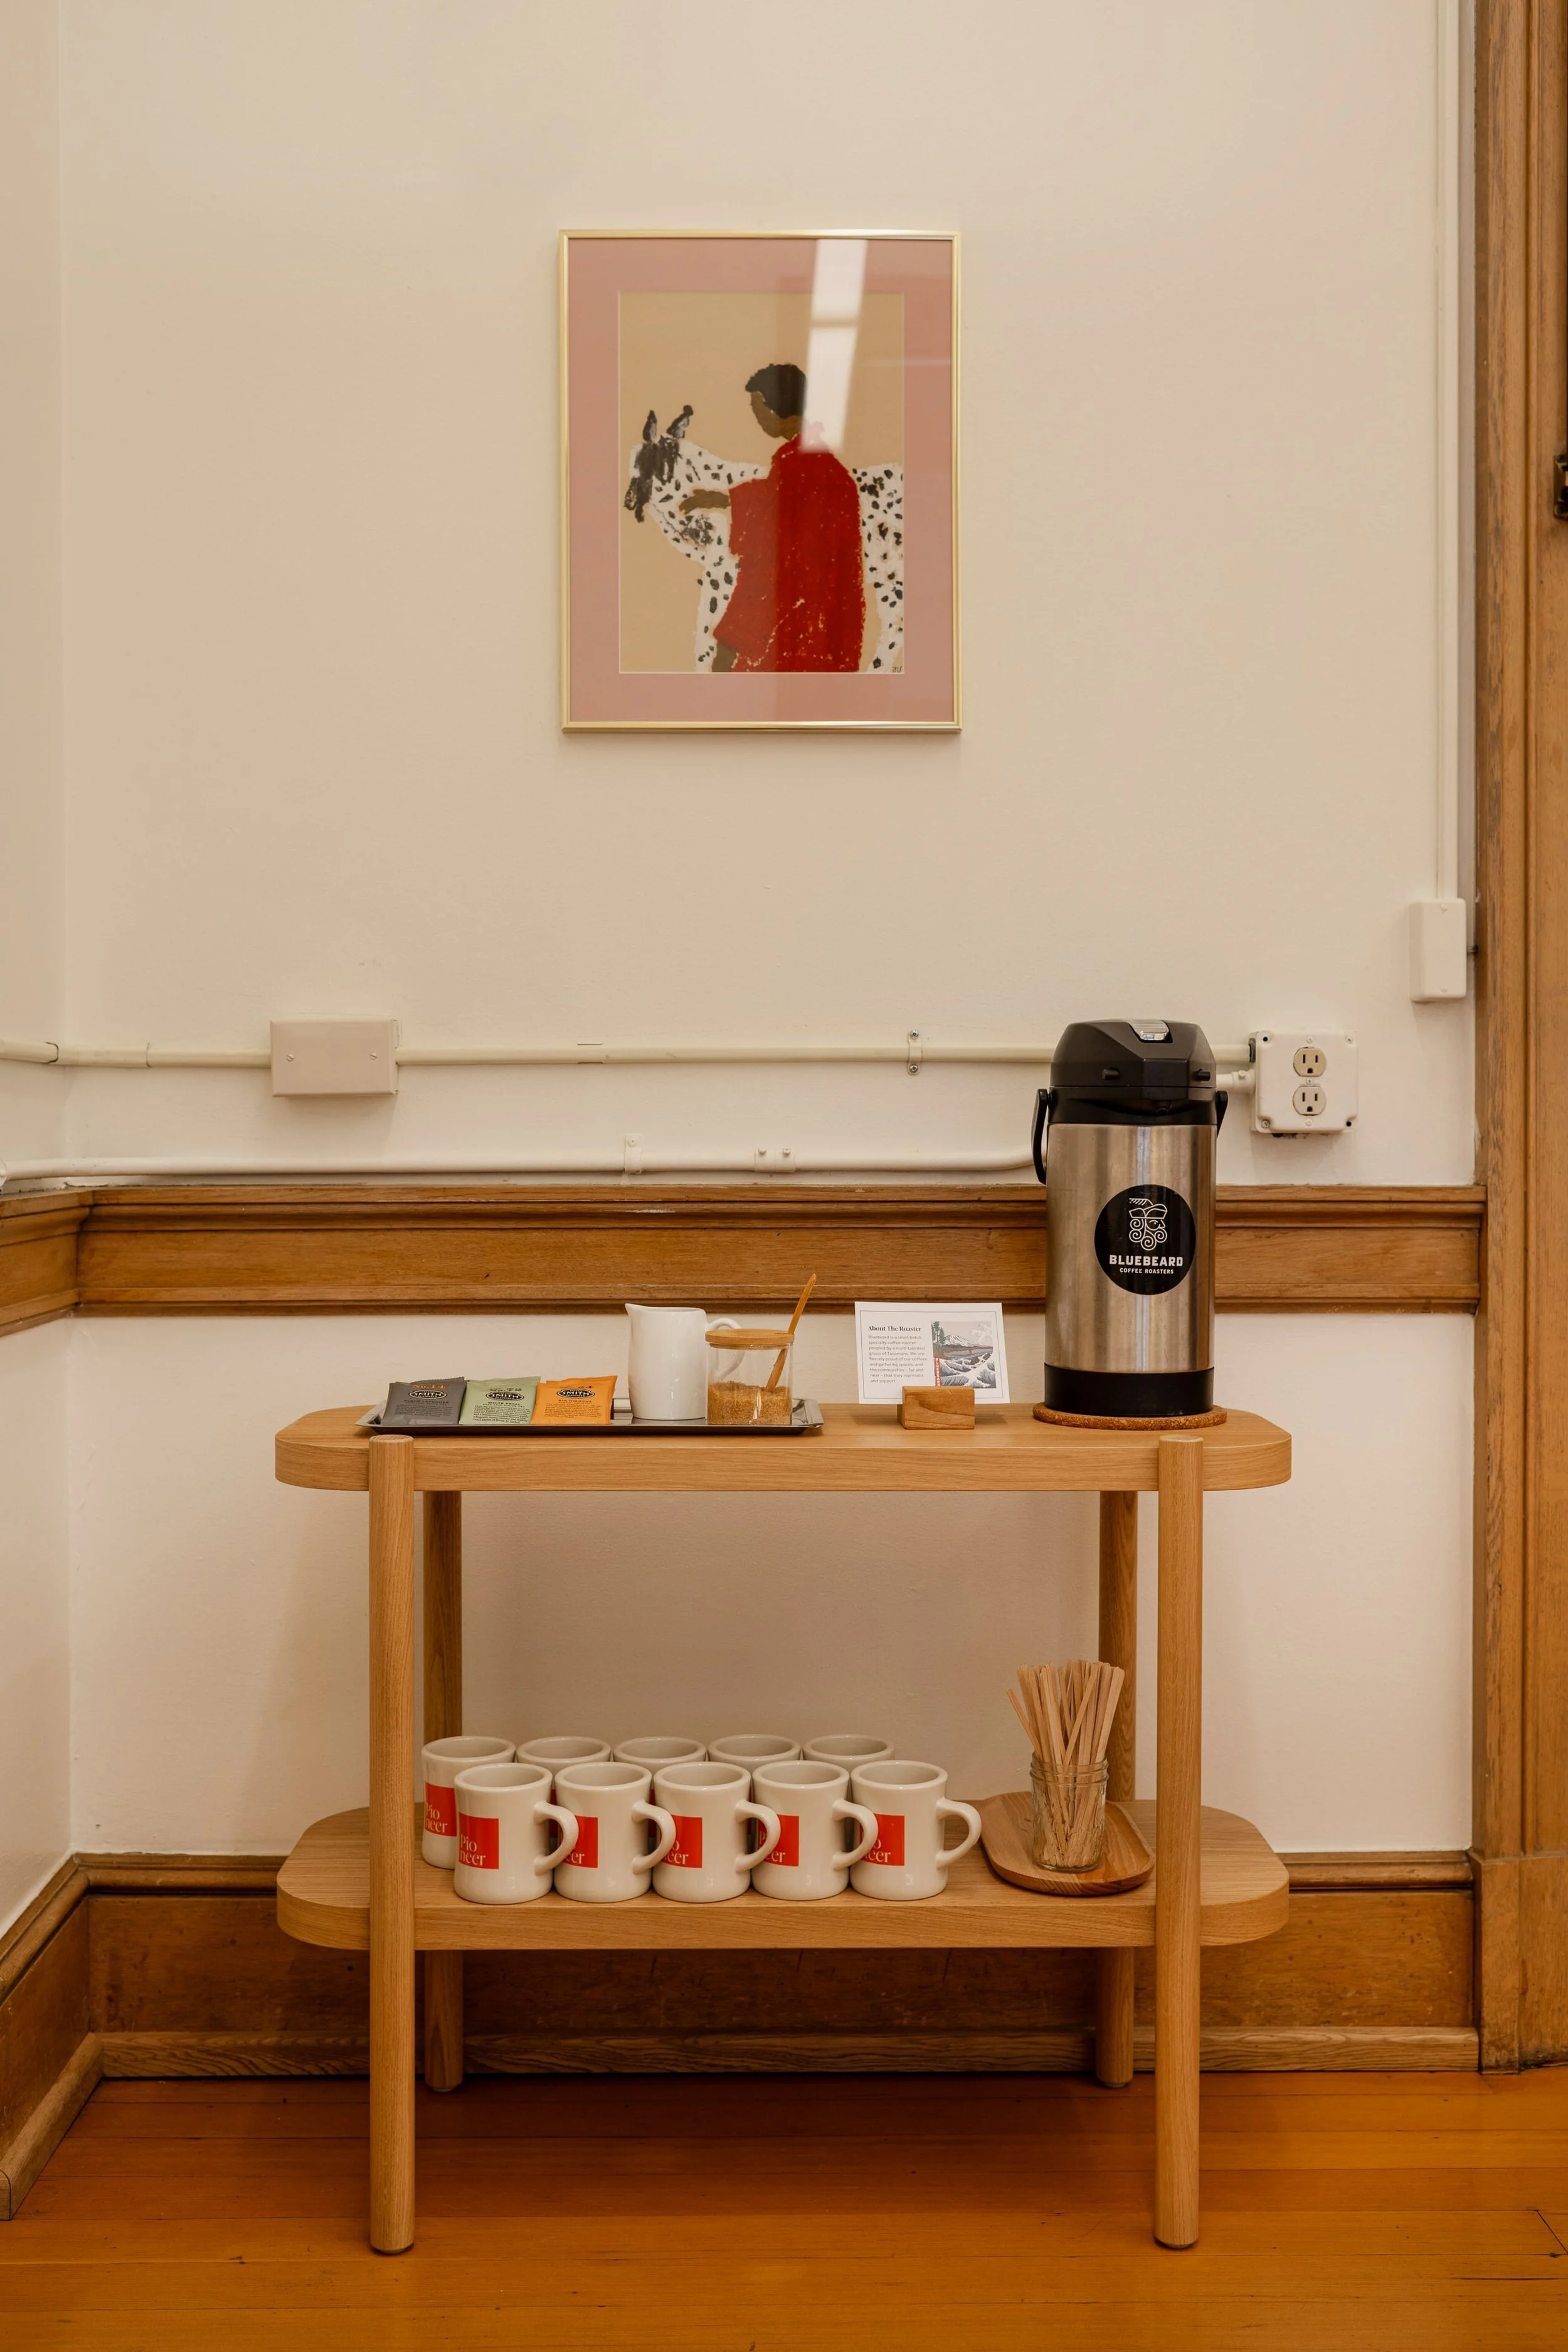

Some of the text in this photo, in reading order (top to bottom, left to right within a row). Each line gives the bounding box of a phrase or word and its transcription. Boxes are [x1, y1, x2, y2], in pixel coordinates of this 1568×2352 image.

[1110, 1255, 1183, 1266] BLUEBEARD
[426, 1803, 440, 1820] Pio
[426, 1816, 447, 1833] neer
[460, 1834, 477, 1852] Pio
[460, 1850, 486, 1867] neer
[665, 1851, 689, 1864] eer
[866, 1850, 891, 1863] eer
